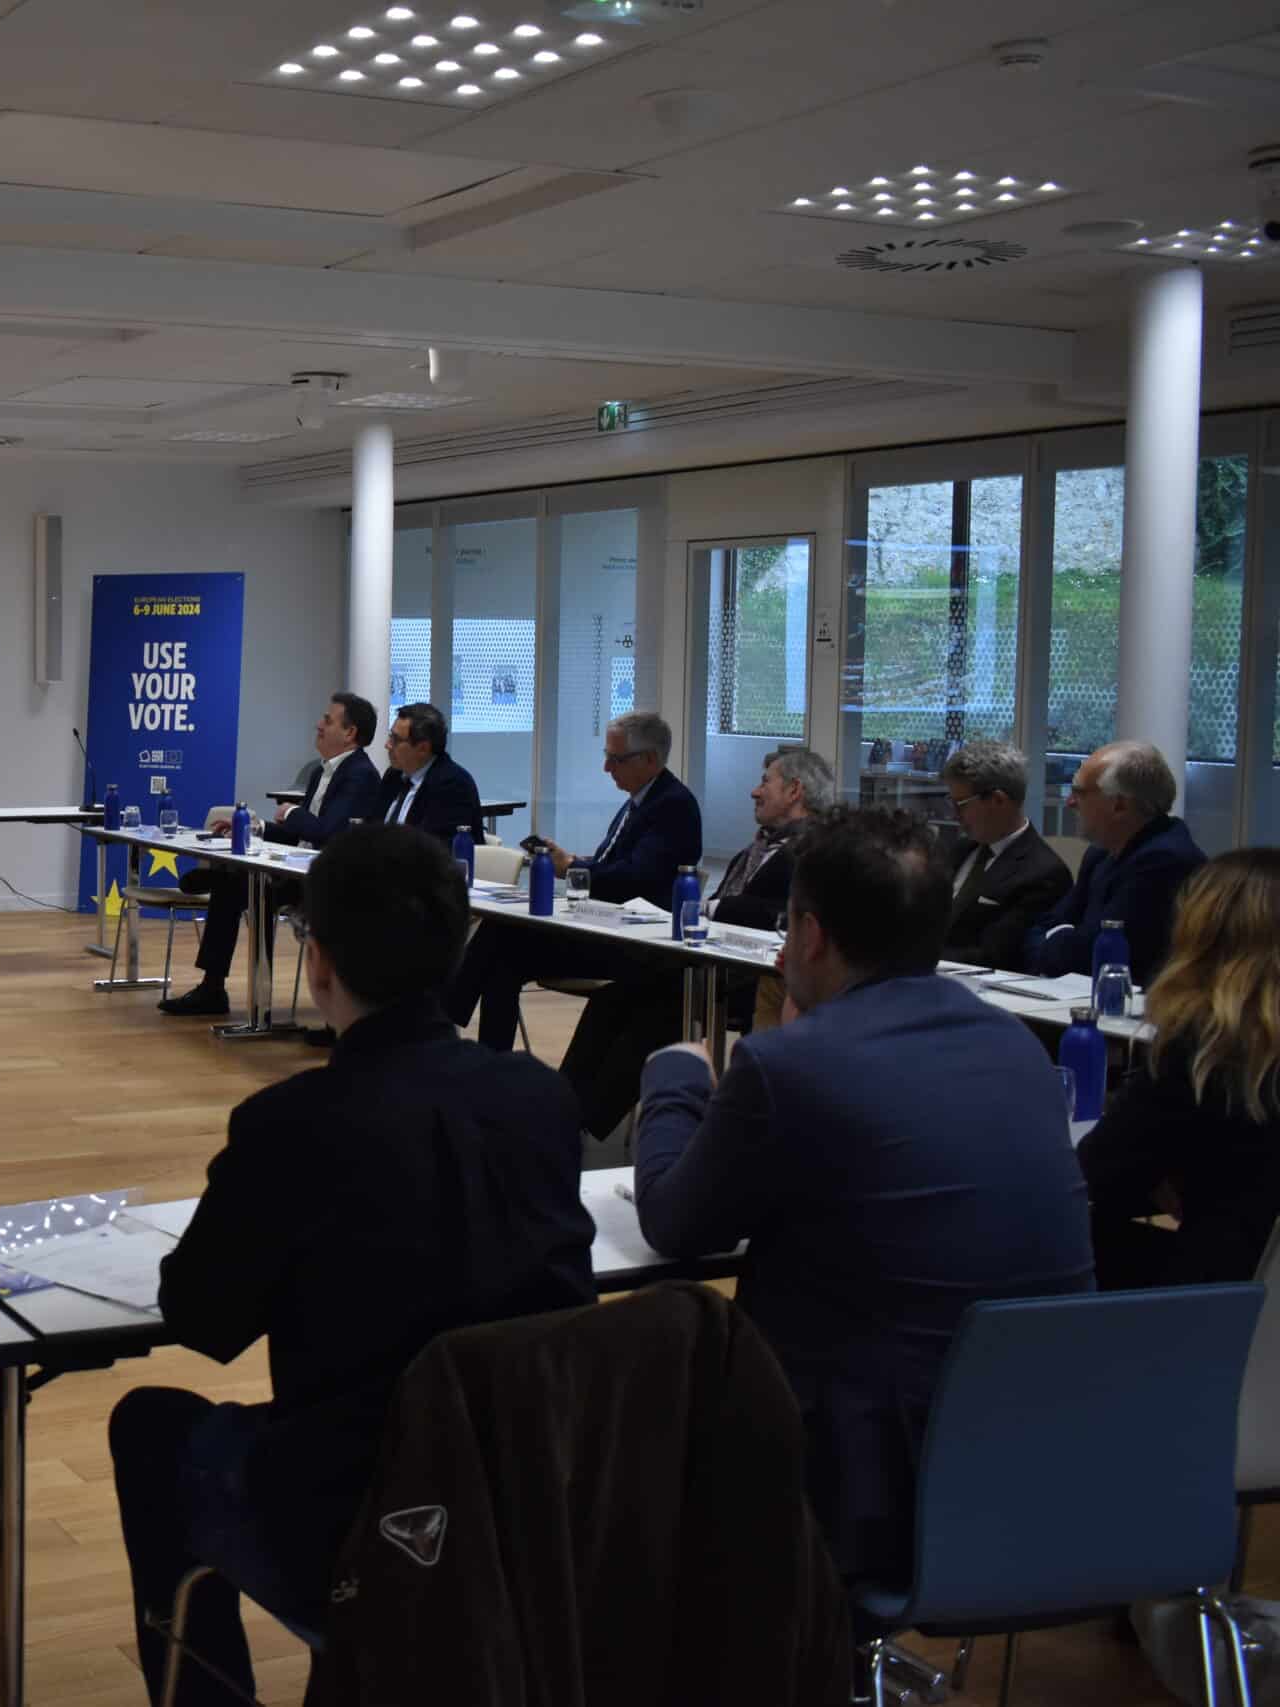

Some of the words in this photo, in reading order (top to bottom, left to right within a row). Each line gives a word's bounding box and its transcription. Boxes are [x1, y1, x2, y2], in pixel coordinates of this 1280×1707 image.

[133, 604, 150, 616] 6-9
[151, 604, 177, 616] JUNE
[177, 603, 200, 615] 2024
[143, 641, 187, 670] USE
[131, 672, 196, 701] YOUR
[128, 703, 195, 731] VOTE.
